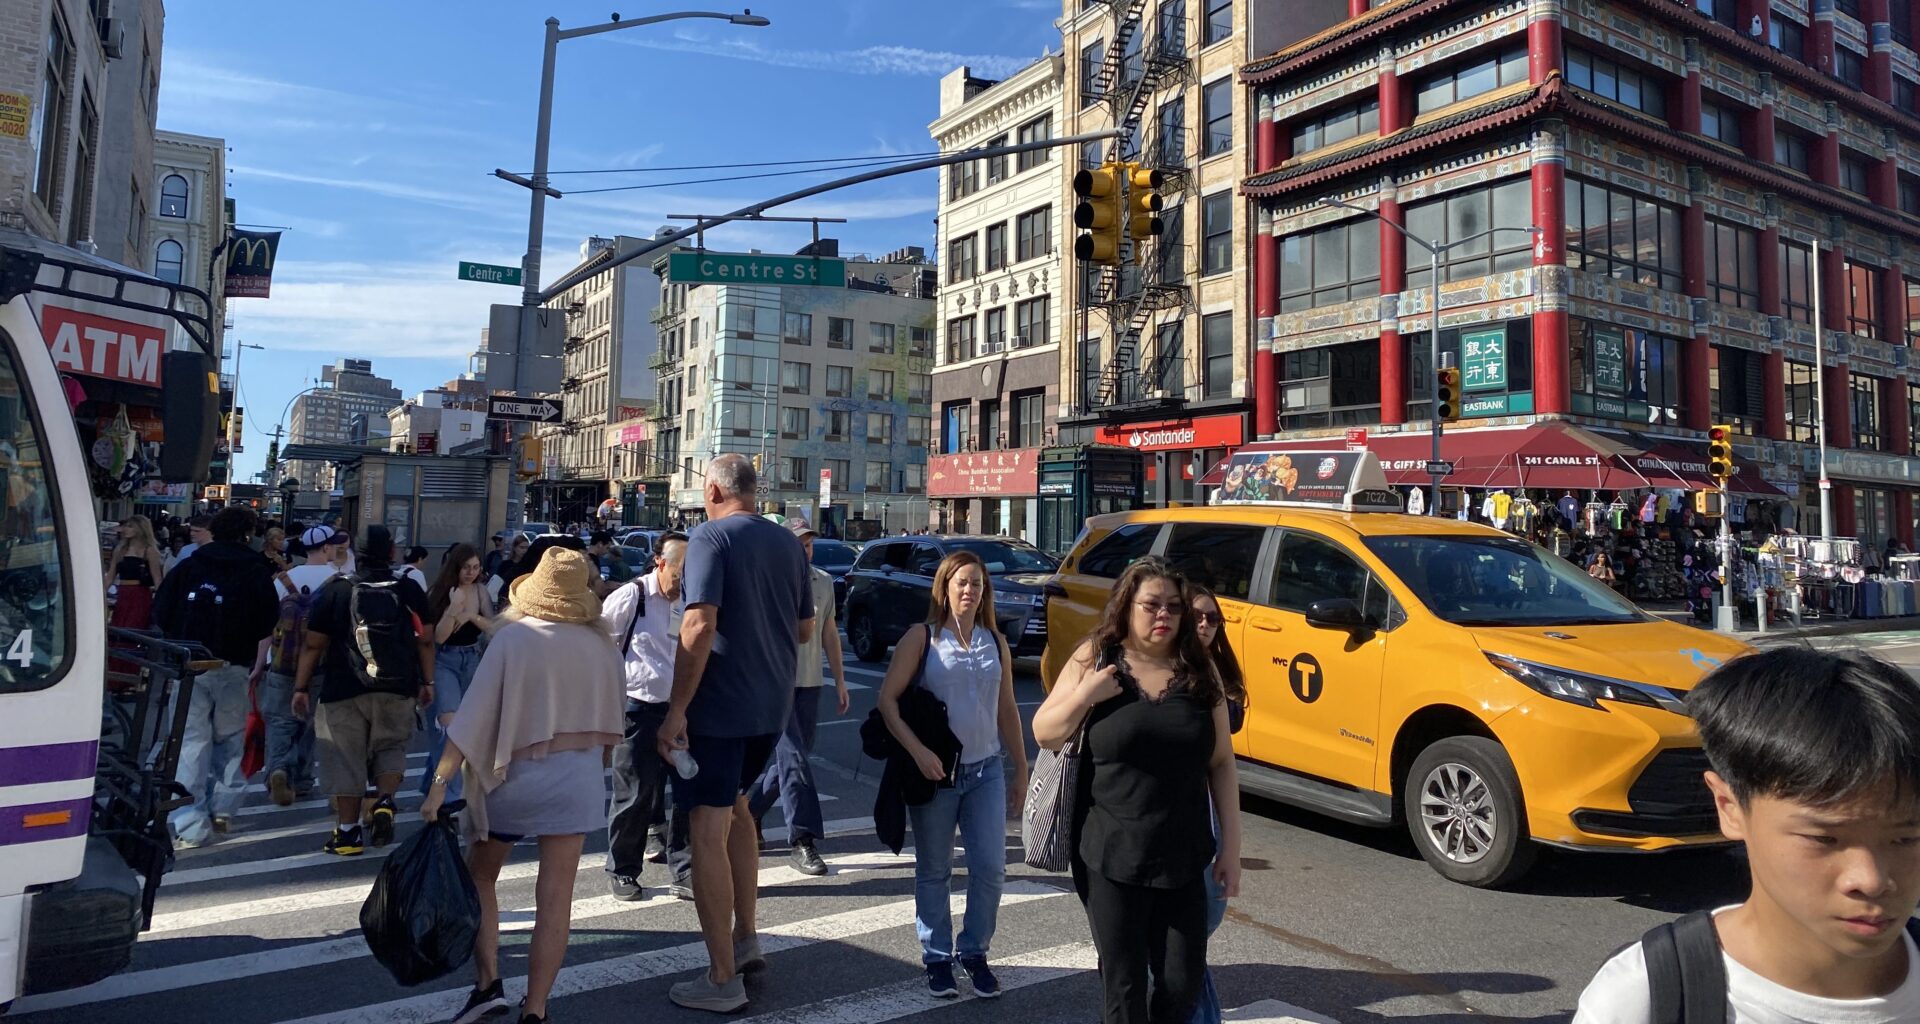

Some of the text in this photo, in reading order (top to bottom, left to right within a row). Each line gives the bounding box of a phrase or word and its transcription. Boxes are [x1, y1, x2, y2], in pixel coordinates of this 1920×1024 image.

[468, 264, 513, 282] Centre St
[700, 260, 817, 280] Centre St
[50, 321, 159, 383] ATM
[499, 403, 552, 416] ONE WAY
[1464, 400, 1504, 412] EASTBANK
[1596, 402, 1625, 413] EASTBANK
[1142, 429, 1196, 446] Santander
[1394, 460, 1415, 469] GIFT
[1525, 457, 1541, 465] 241
[1545, 457, 1582, 465] CANAL
[1637, 458, 1680, 471] CHINATOWN
[1681, 462, 1706, 472] CENTER
[756, 486, 769, 494] 20
[1366, 492, 1387, 503] 7C22
[1272, 657, 1316, 697] NYC T
